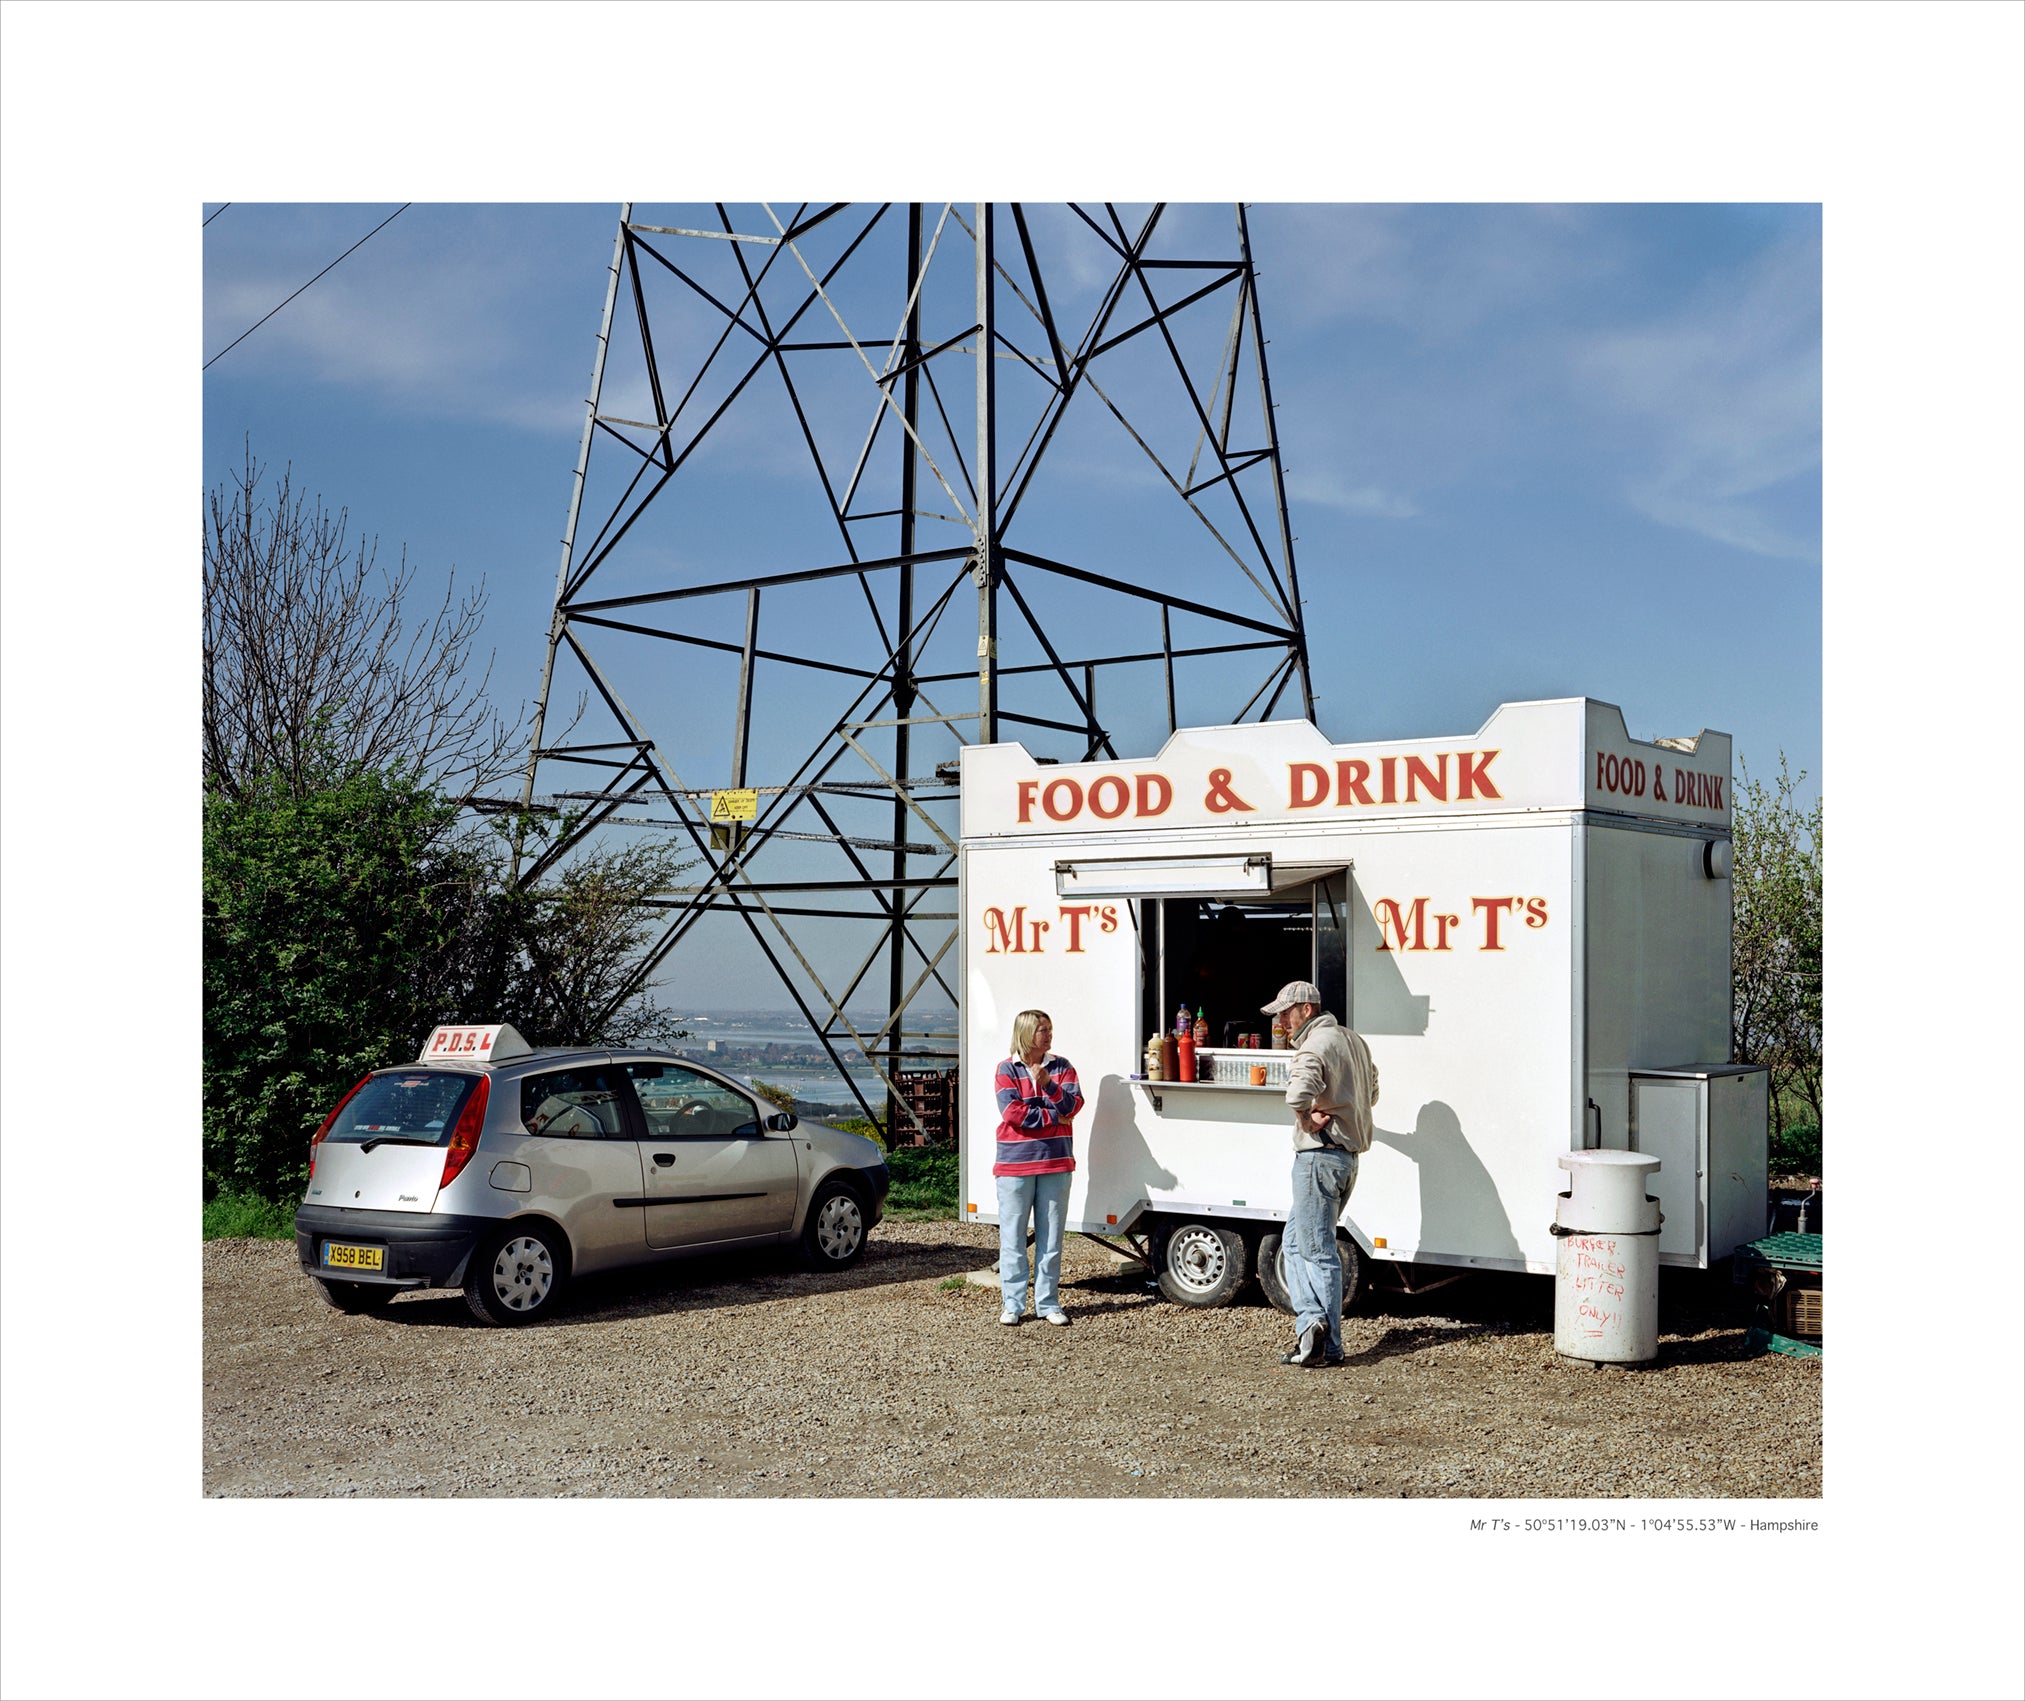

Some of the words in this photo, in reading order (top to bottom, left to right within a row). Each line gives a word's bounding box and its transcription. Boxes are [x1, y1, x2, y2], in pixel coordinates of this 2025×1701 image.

[1016, 772, 1173, 824] FOOD
[1204, 766, 1258, 813] &
[1286, 749, 1504, 811] DRINK
[1596, 751, 1647, 797] FOOD
[1653, 764, 1668, 802] &
[1674, 768, 1724, 810] DRINK
[983, 904, 1050, 954] Mr
[1058, 904, 1118, 953] T's
[1373, 896, 1460, 952] Mr
[1470, 896, 1549, 952] T's
[432, 1032, 477, 1052] P.D.S.
[480, 1033, 491, 1050] L
[330, 1245, 356, 1265] X958
[358, 1248, 380, 1267] BEL
[1577, 1253, 1626, 1279] TRAILER
[1576, 1276, 1625, 1302] LITTER
